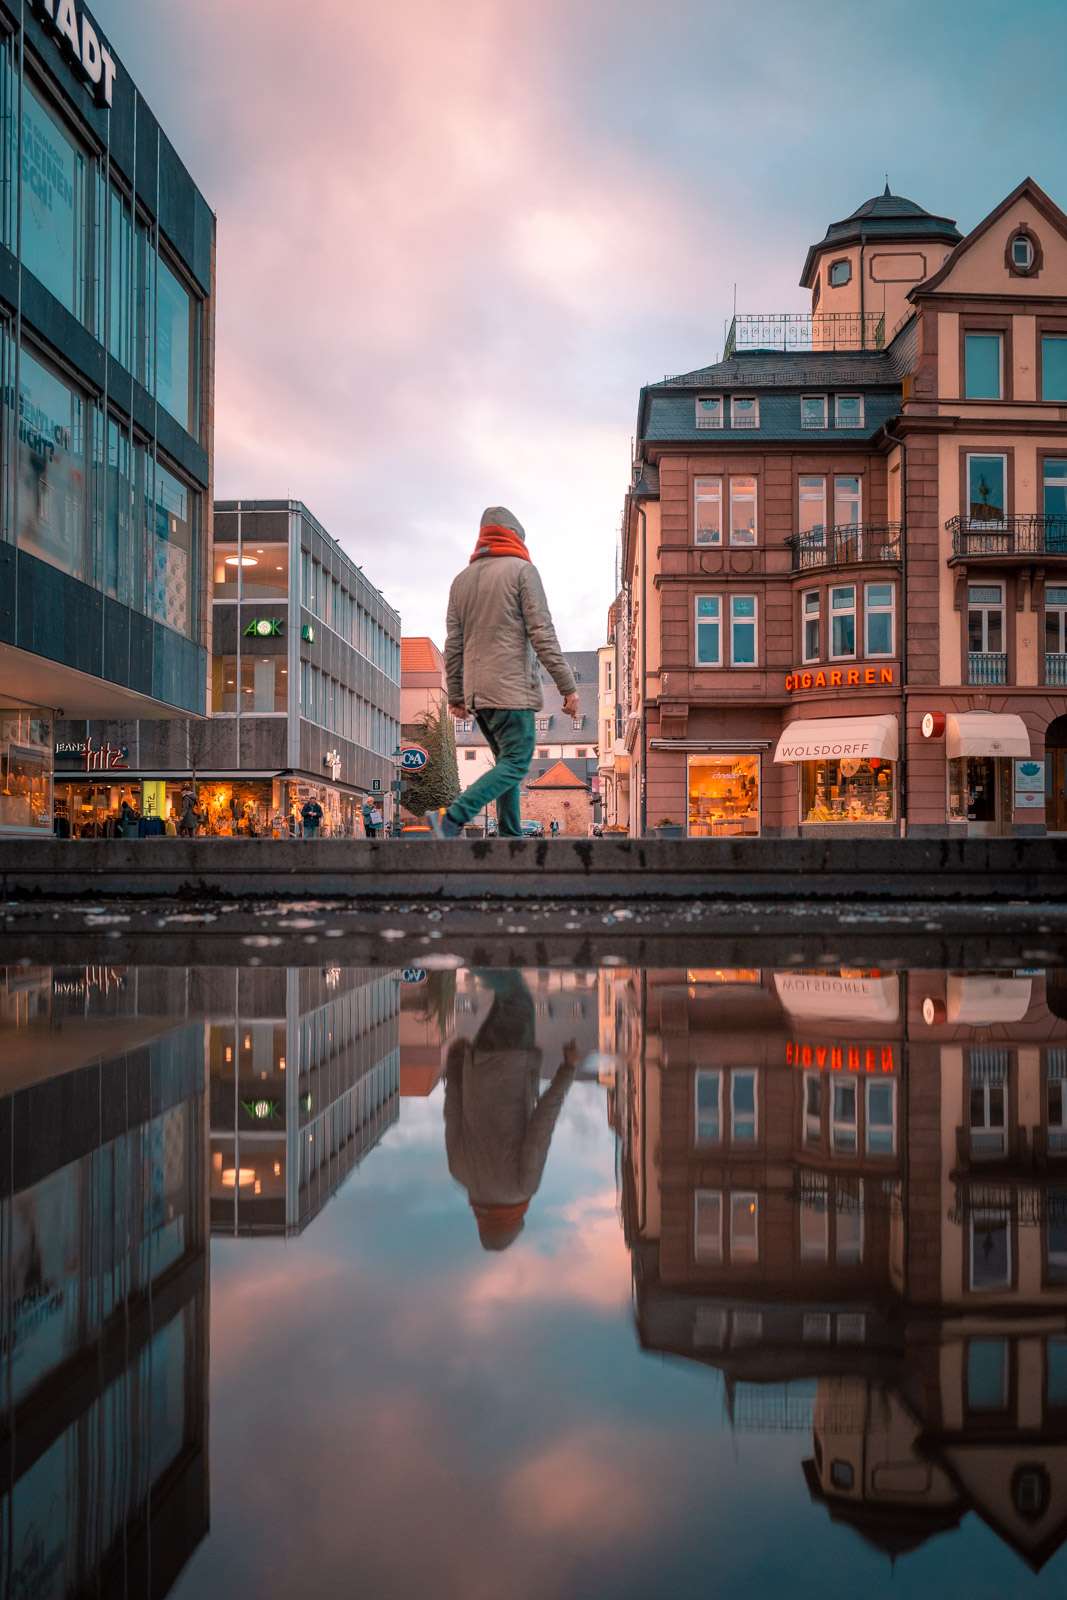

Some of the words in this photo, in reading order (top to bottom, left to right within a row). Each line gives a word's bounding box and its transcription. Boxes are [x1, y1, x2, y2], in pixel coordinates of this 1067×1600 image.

[35, 0, 117, 108] ADT
[243, 617, 284, 637] AOK
[785, 667, 893, 691] CIGARREN
[55, 743, 87, 754] JEANS
[80, 736, 130, 773] fritz
[402, 752, 424, 766] C&A
[781, 742, 870, 757] WOLSDORFF
